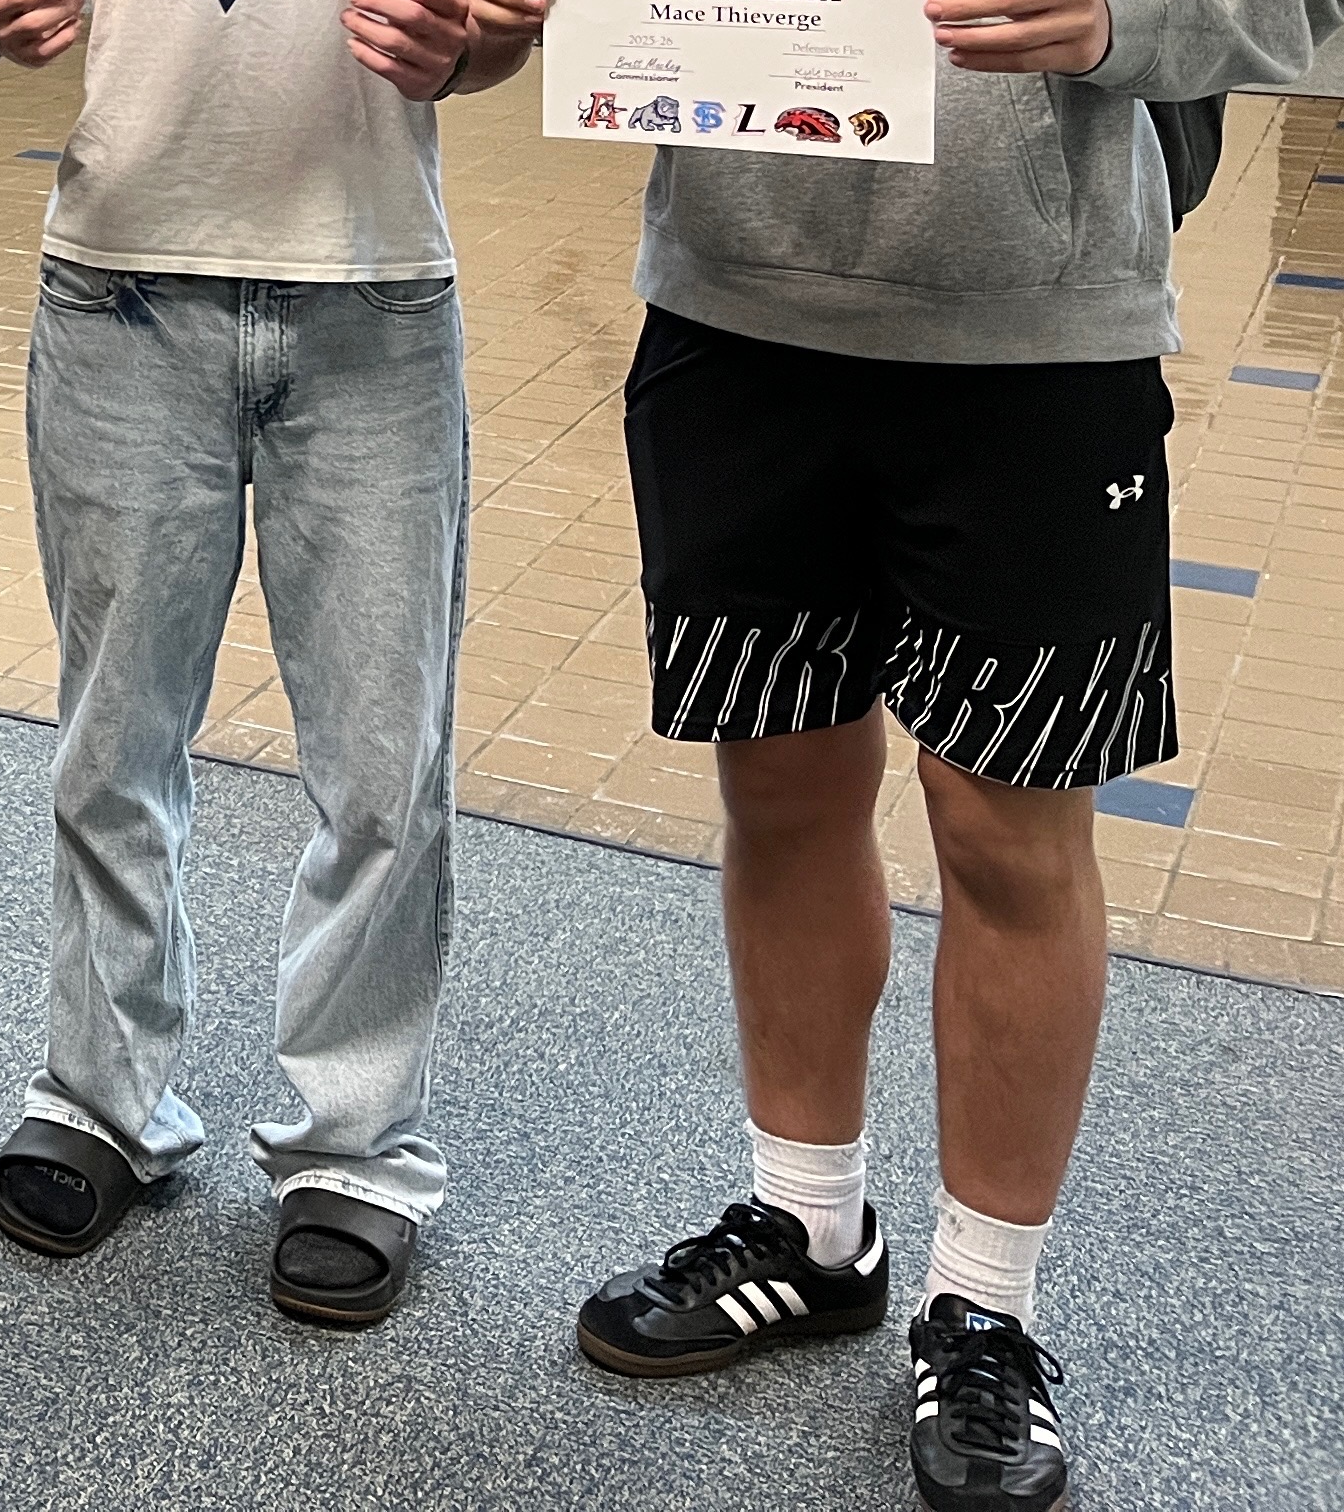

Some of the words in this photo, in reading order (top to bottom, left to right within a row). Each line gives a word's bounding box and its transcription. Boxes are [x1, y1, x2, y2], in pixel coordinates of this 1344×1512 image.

[648, 4, 705, 24] Mace
[712, 6, 824, 31] Thieverge
[609, 72, 679, 82] Commissioner
[795, 81, 843, 91] President
